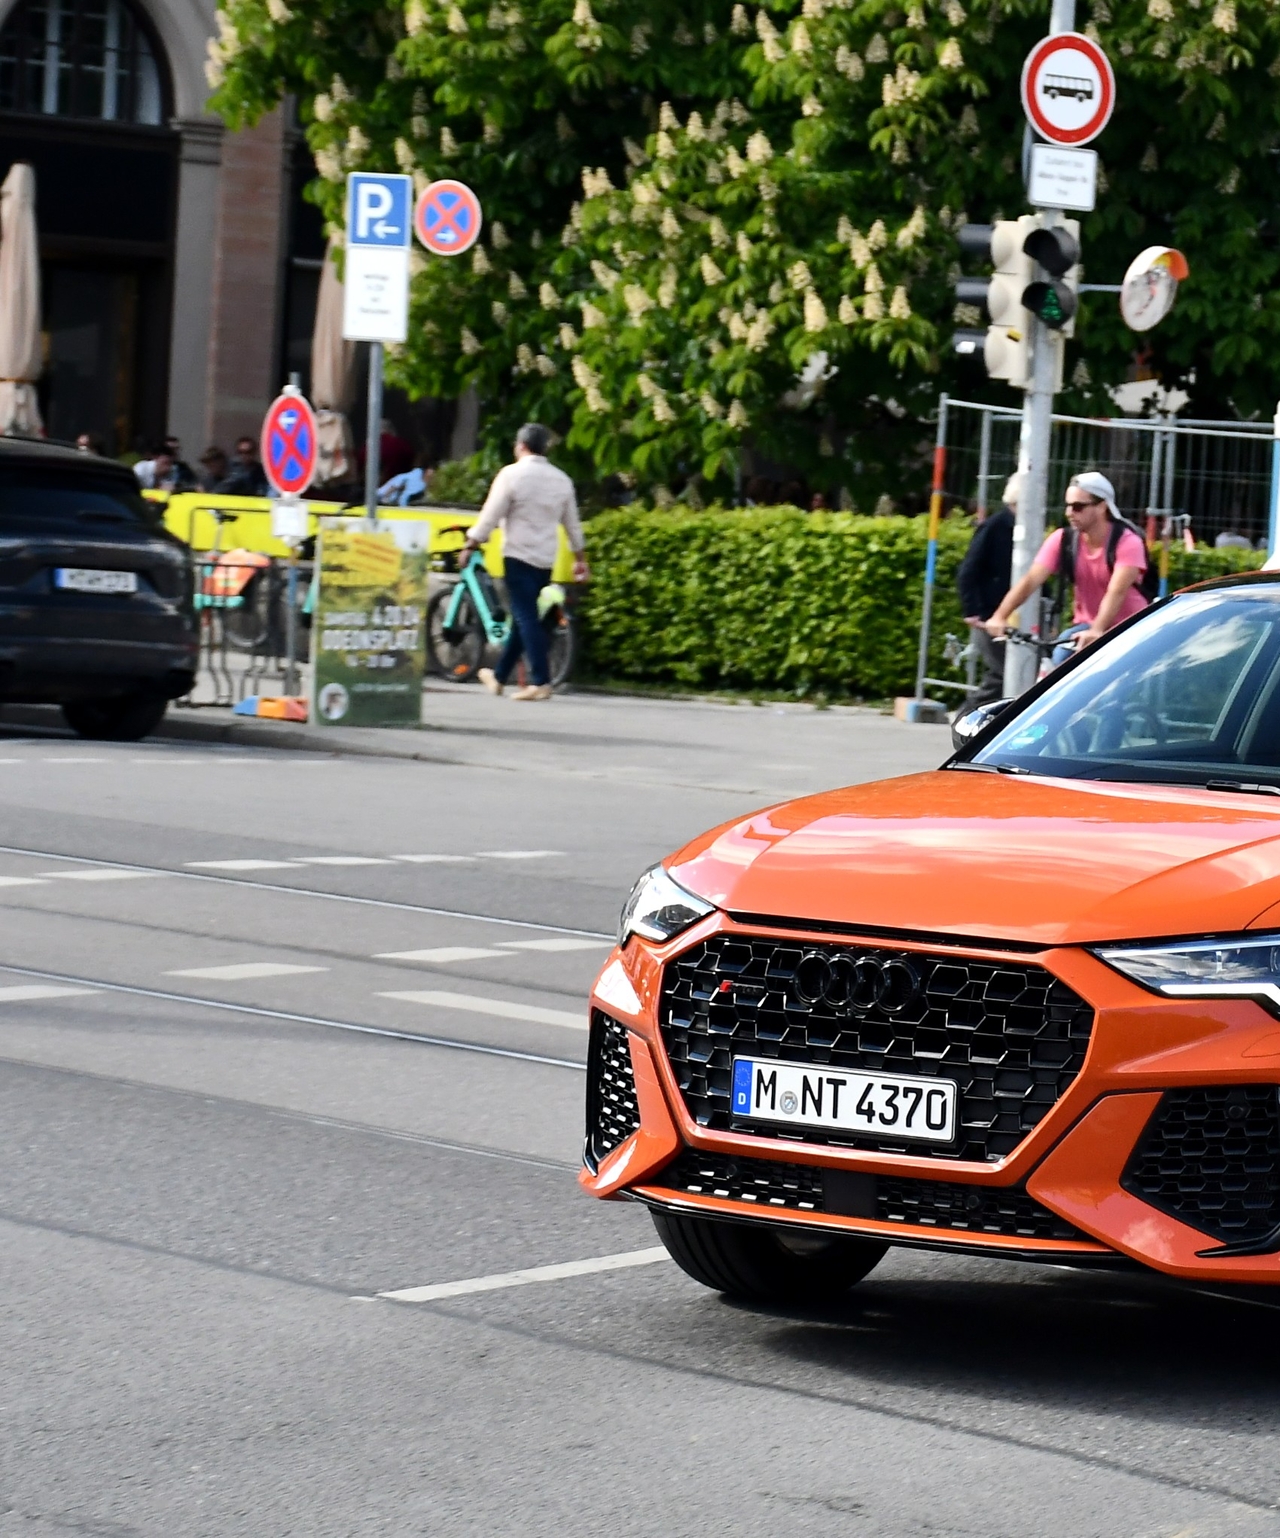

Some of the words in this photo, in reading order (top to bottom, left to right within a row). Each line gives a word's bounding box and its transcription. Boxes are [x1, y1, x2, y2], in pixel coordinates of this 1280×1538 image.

[357, 183, 393, 238] P
[755, 1068, 777, 1111] M
[801, 1075, 847, 1119] NT
[856, 1082, 949, 1131] 4370
